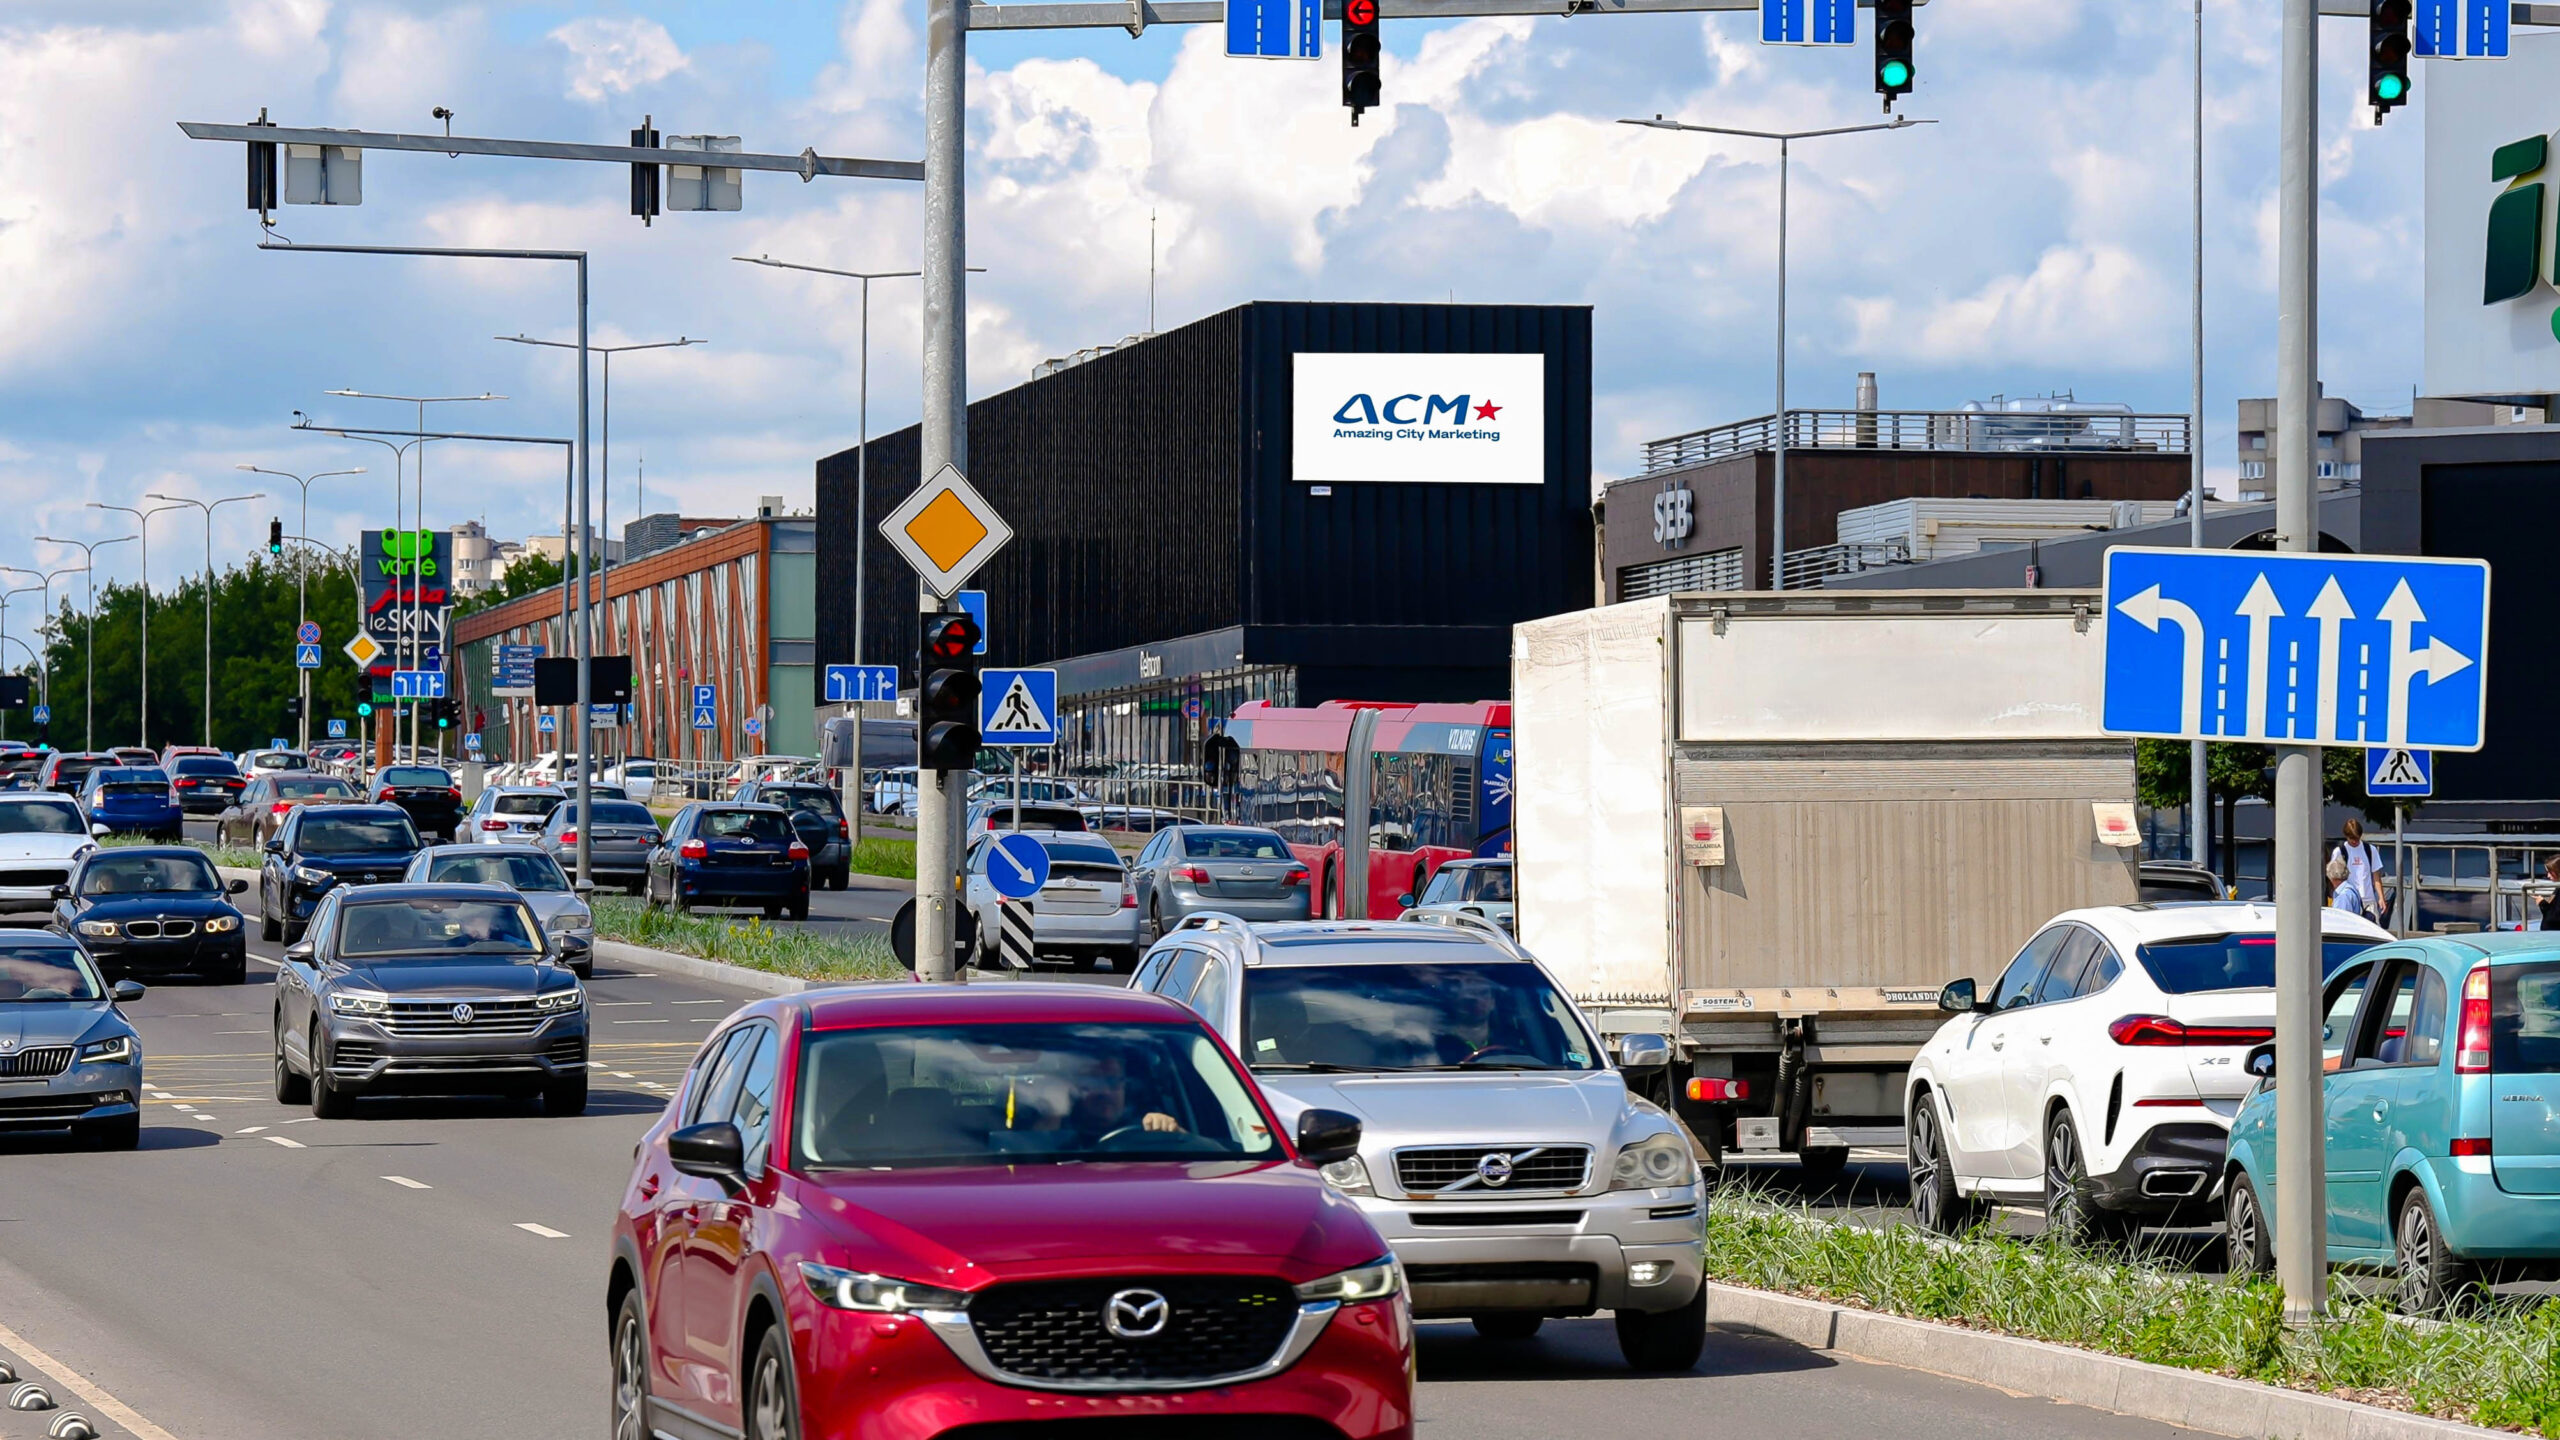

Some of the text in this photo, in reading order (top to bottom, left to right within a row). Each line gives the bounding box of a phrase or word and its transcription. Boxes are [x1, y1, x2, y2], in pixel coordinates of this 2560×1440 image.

[1333, 393, 1471, 425] ACM
[1333, 428, 1501, 442] Amazing City Marketing
[1653, 488, 1693, 543] SEB
[699, 687, 712, 705] P
[1448, 729, 1476, 751] VILNIUS
[1885, 992, 1940, 1002] DHOLLANDIA
